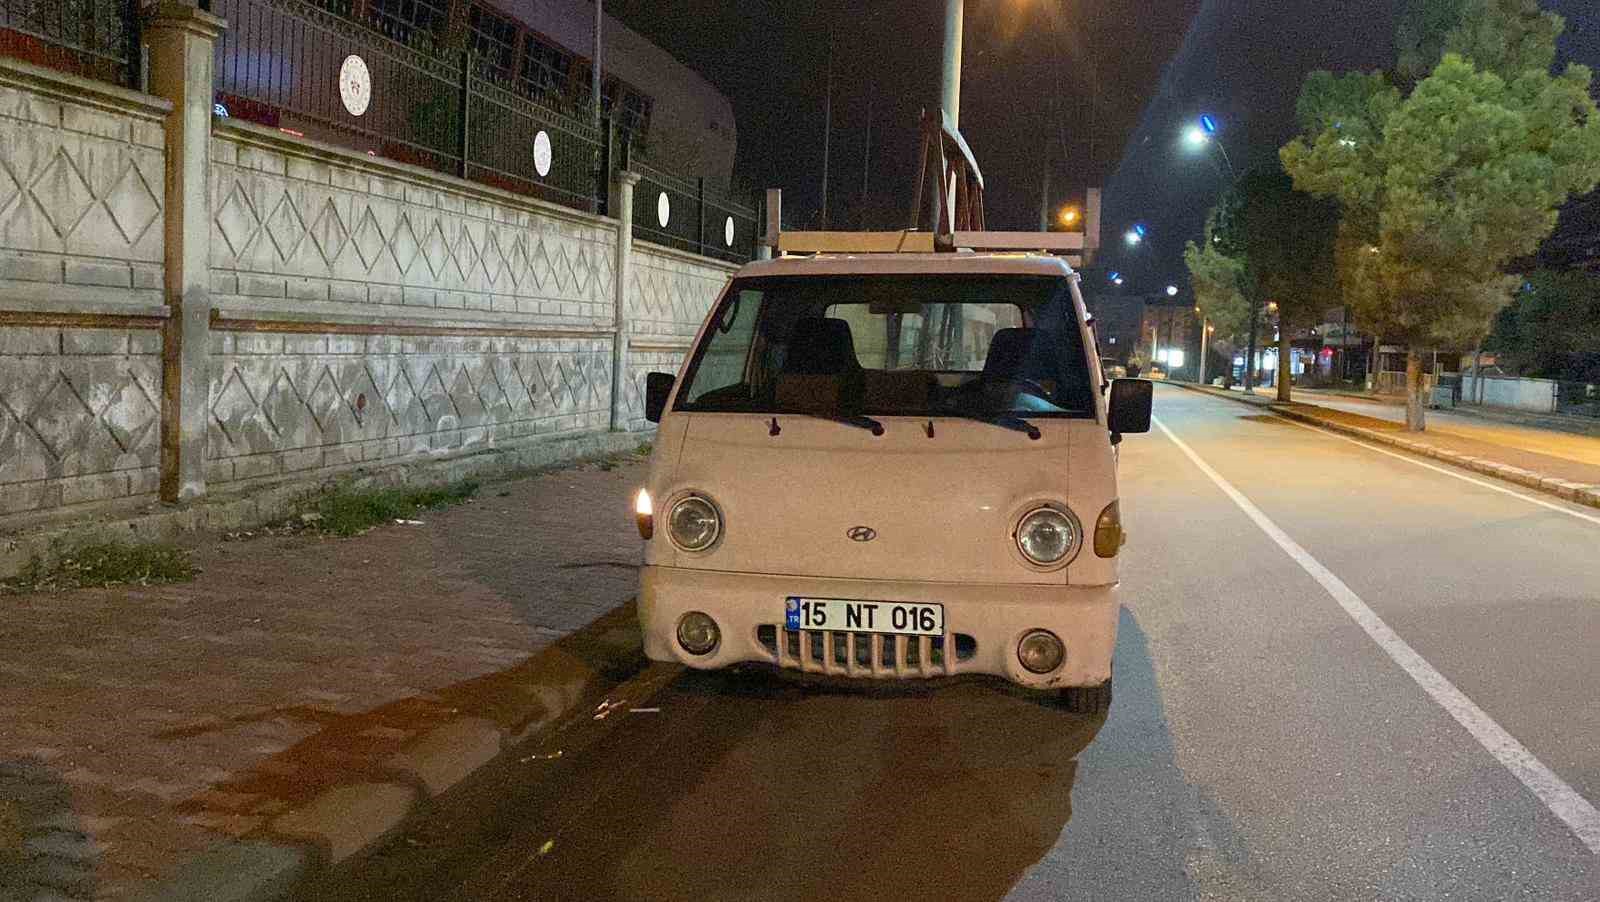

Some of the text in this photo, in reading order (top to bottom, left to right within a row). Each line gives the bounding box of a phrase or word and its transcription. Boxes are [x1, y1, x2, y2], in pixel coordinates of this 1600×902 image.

[789, 615, 800, 624] TR
[801, 602, 936, 631] 15 NT 016
